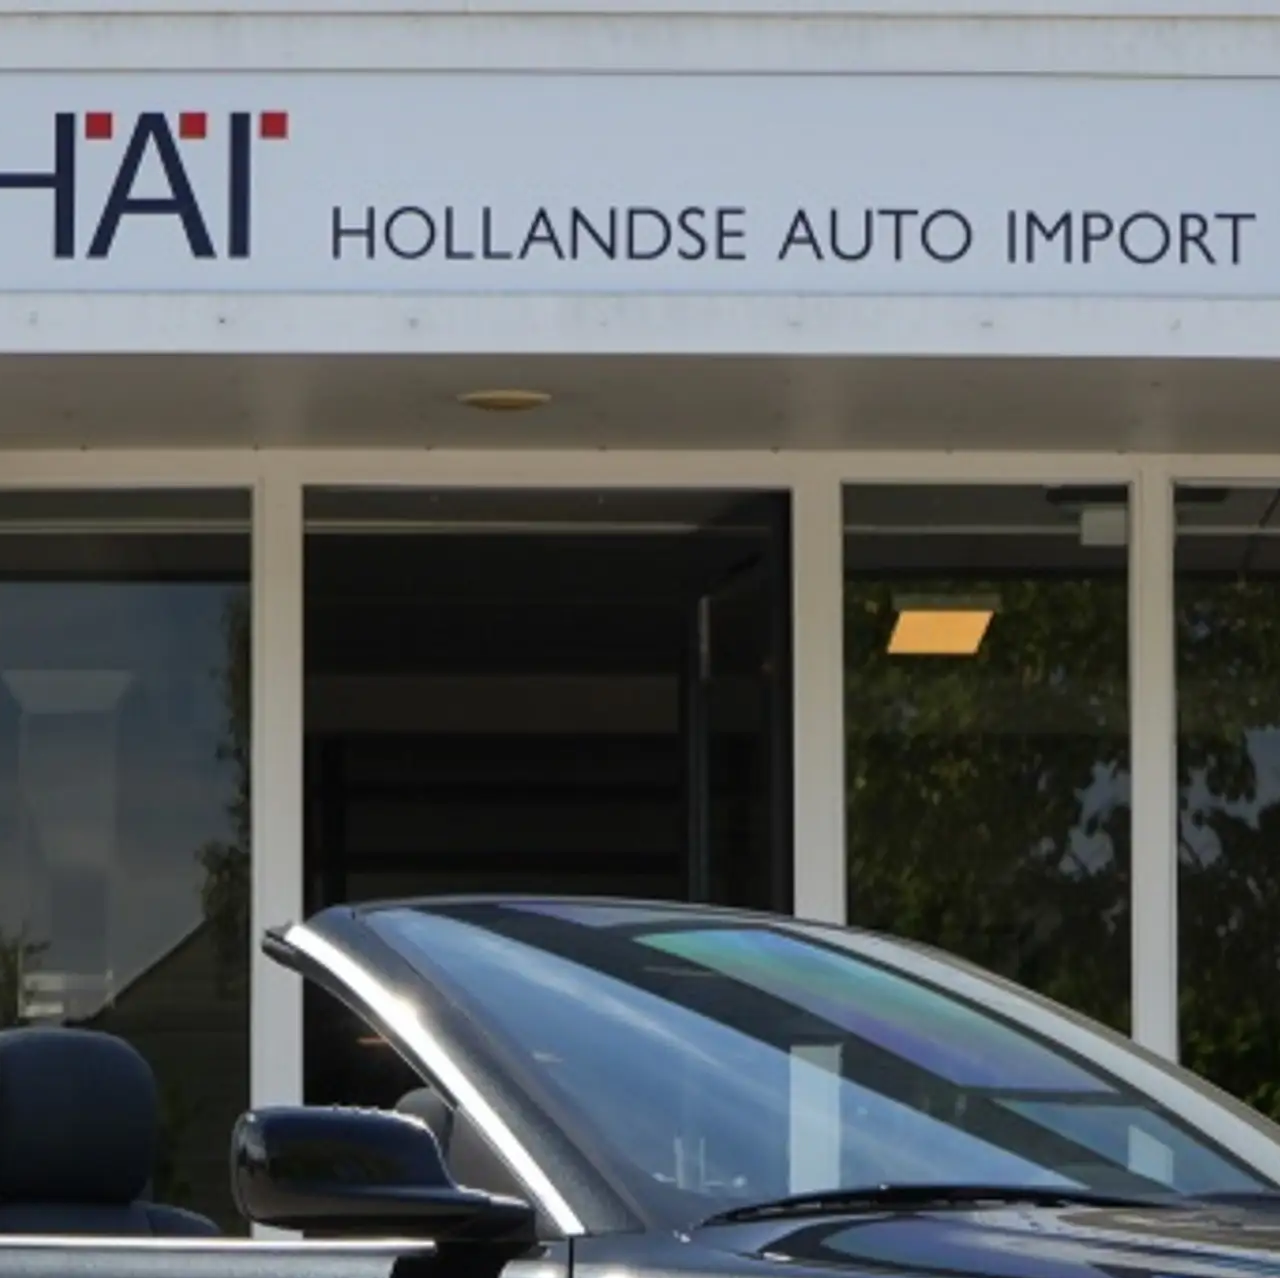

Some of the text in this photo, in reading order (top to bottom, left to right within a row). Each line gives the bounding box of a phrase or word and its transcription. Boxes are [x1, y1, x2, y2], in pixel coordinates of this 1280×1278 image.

[332, 205, 1256, 265] HOLLANDSE AUTO IMPORT
